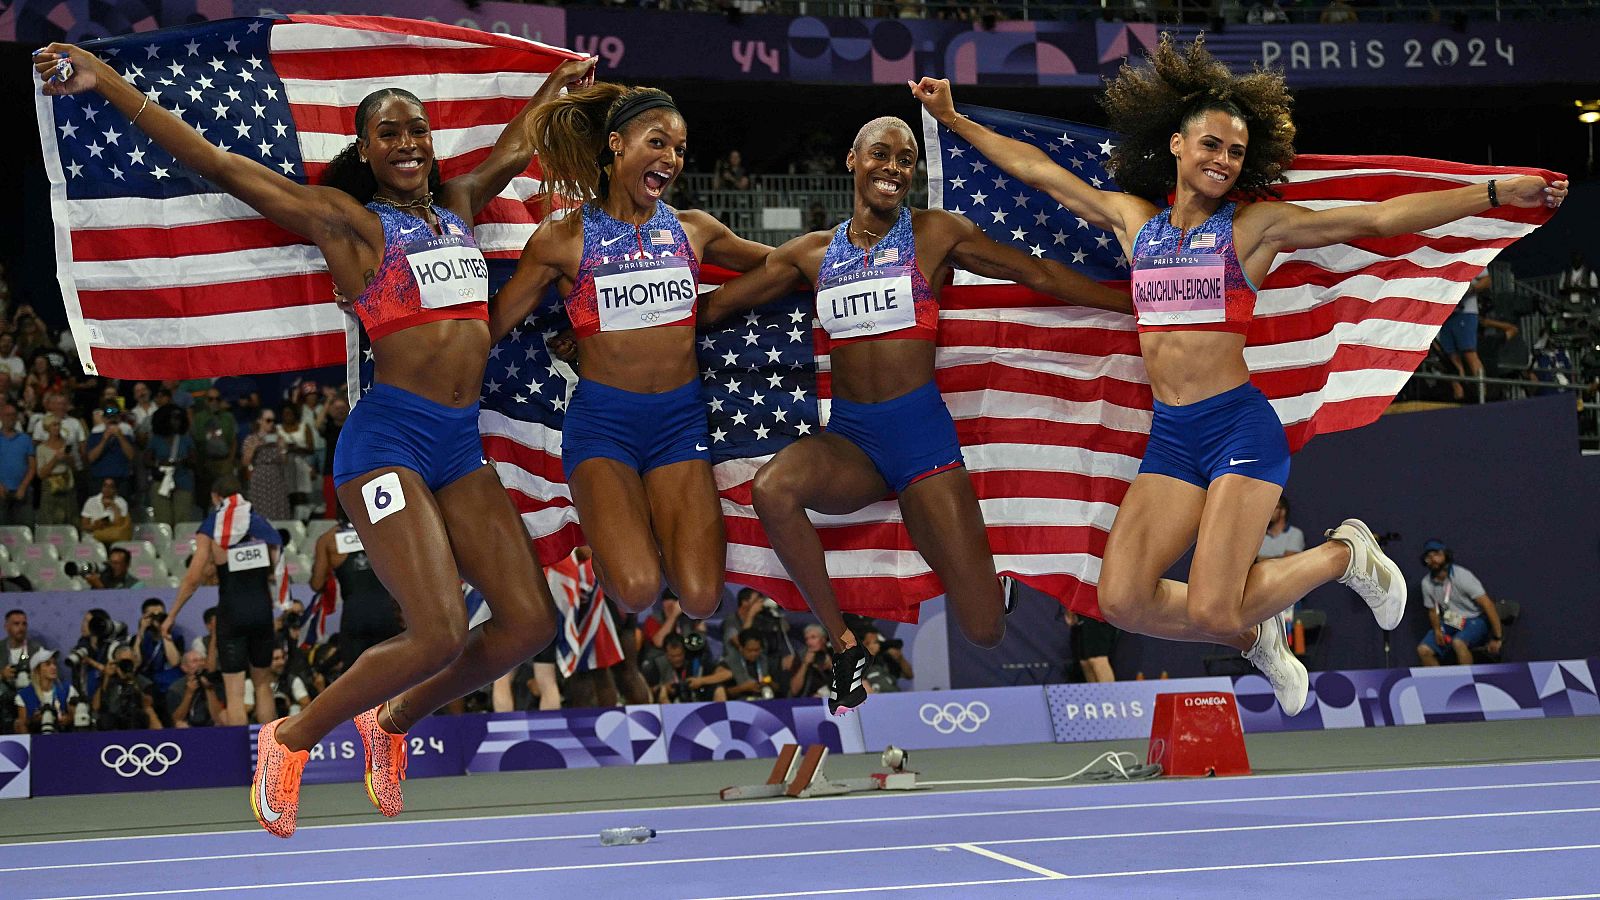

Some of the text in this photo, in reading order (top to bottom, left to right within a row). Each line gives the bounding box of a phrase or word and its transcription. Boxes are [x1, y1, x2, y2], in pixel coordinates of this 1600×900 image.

[731, 40, 780, 73] 44
[1404, 38, 1514, 68] 2024
[415, 258, 488, 285] HOLMES
[1153, 257, 1173, 266] PARIS
[838, 270, 884, 283] PARIS 2024
[599, 279, 694, 309] THOMAS
[831, 288, 898, 319] LITTLE
[374, 485, 392, 510] 6
[235, 548, 262, 562] GBR
[1194, 696, 1227, 706] OMEGA
